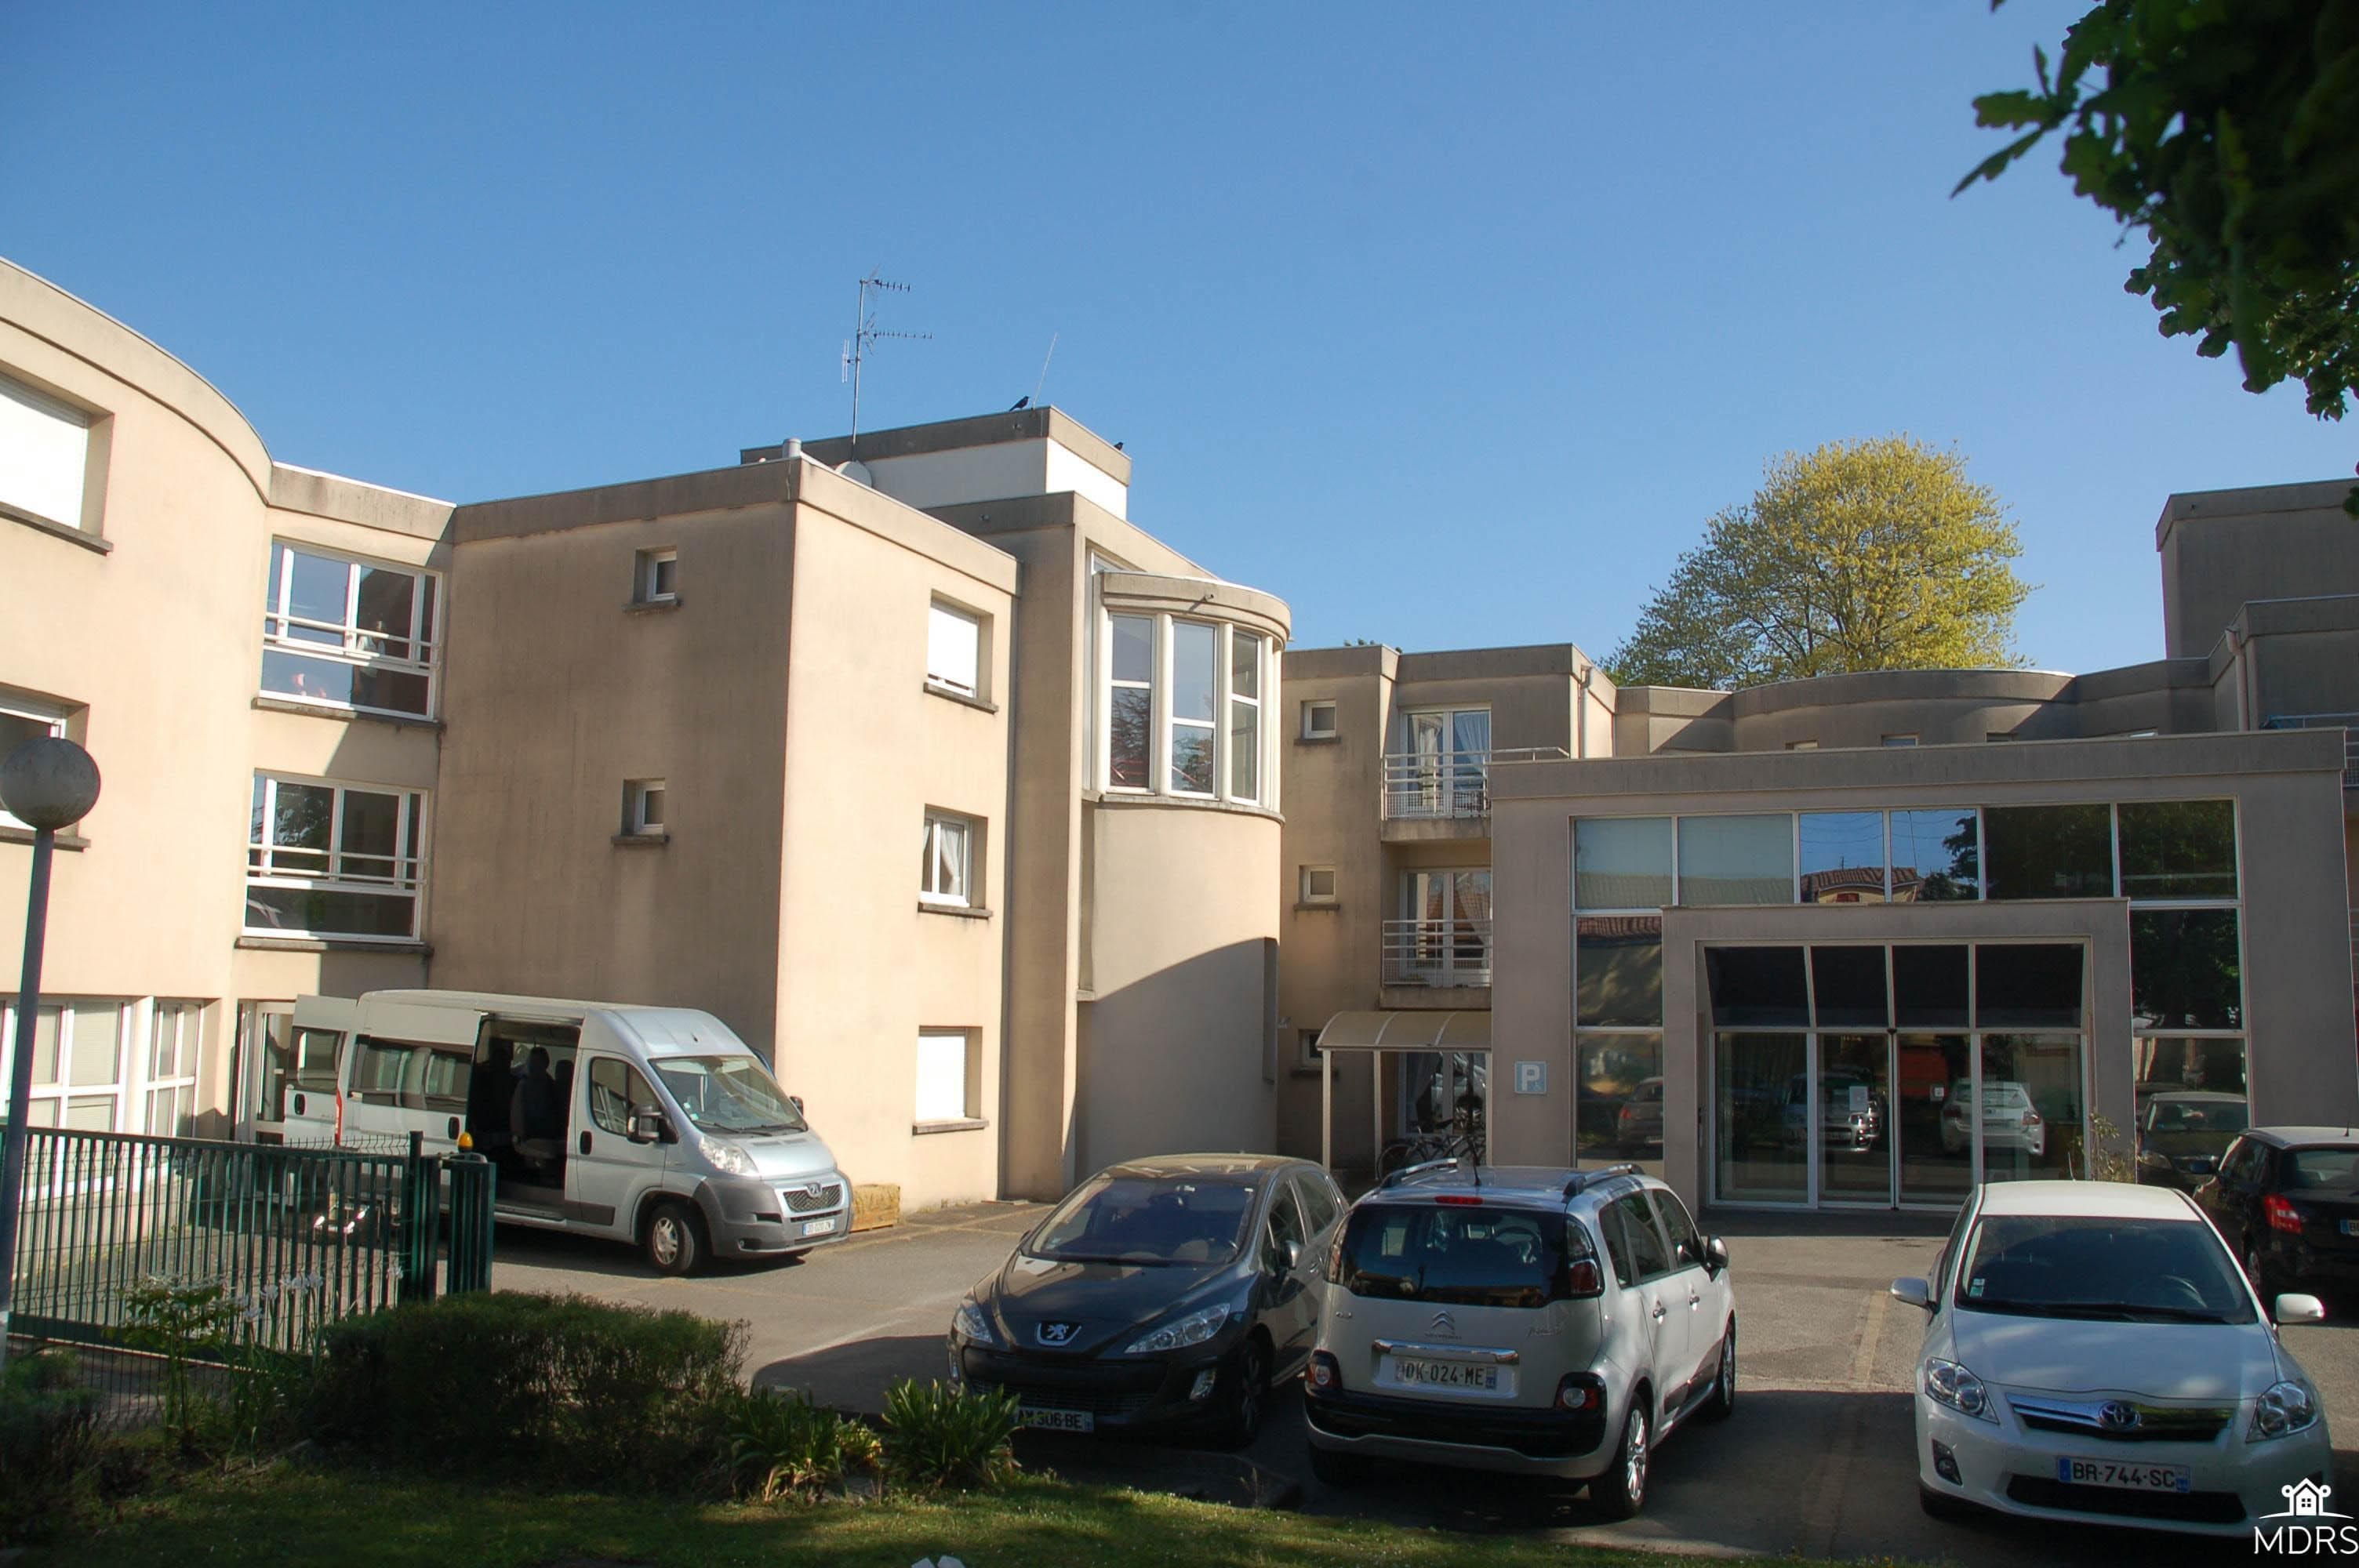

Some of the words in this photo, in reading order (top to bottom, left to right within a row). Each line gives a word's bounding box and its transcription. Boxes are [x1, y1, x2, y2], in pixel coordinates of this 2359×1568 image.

[1522, 1065, 1540, 1091] P
[1405, 1363, 1485, 1385] DK-024-ME
[1019, 1409, 1082, 1427] AM306-BE
[2073, 1463, 2175, 1487] BR-744-SC
